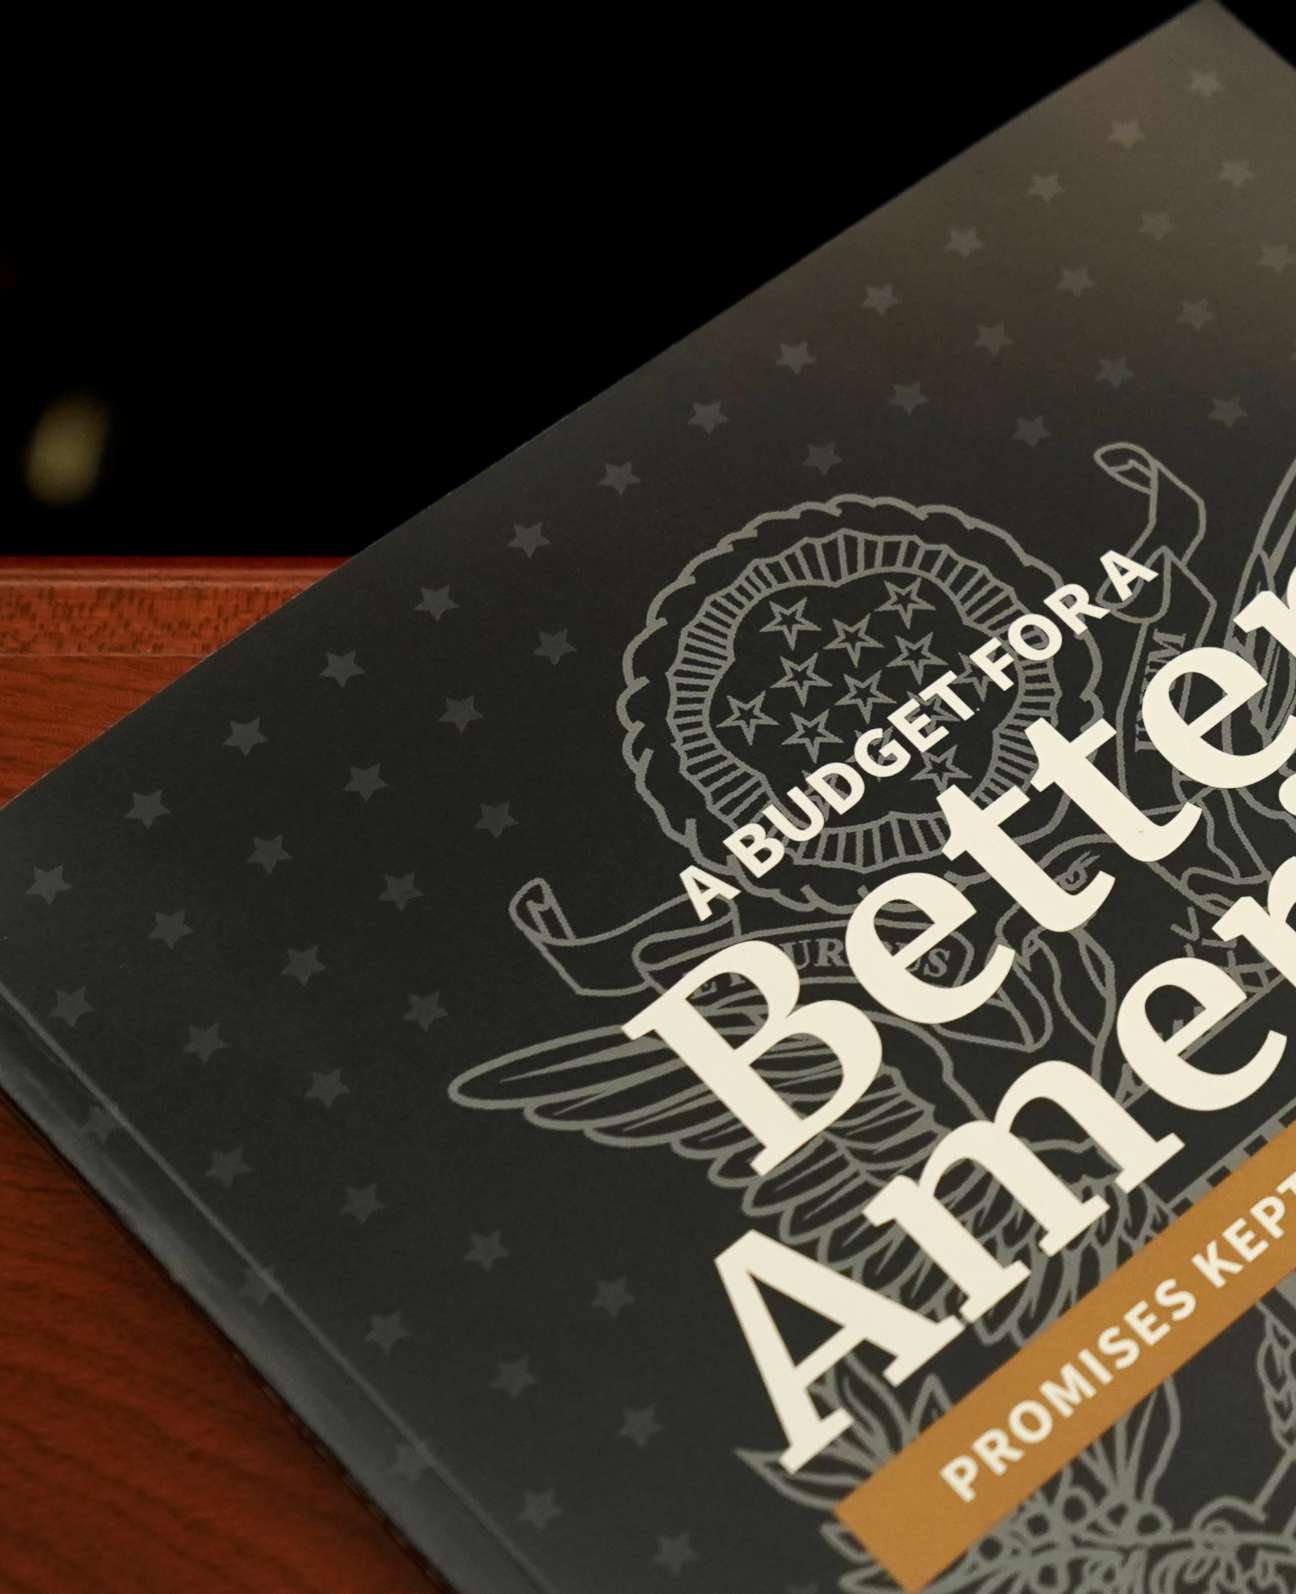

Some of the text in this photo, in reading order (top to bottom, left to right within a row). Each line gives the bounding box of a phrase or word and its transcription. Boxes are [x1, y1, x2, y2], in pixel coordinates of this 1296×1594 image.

[679, 865, 741, 922] A
[722, 670, 975, 879] BUDGET
[969, 583, 1111, 692] FOR
[1099, 549, 1159, 602] A
[940, 1279, 1196, 1502] PROMISES
